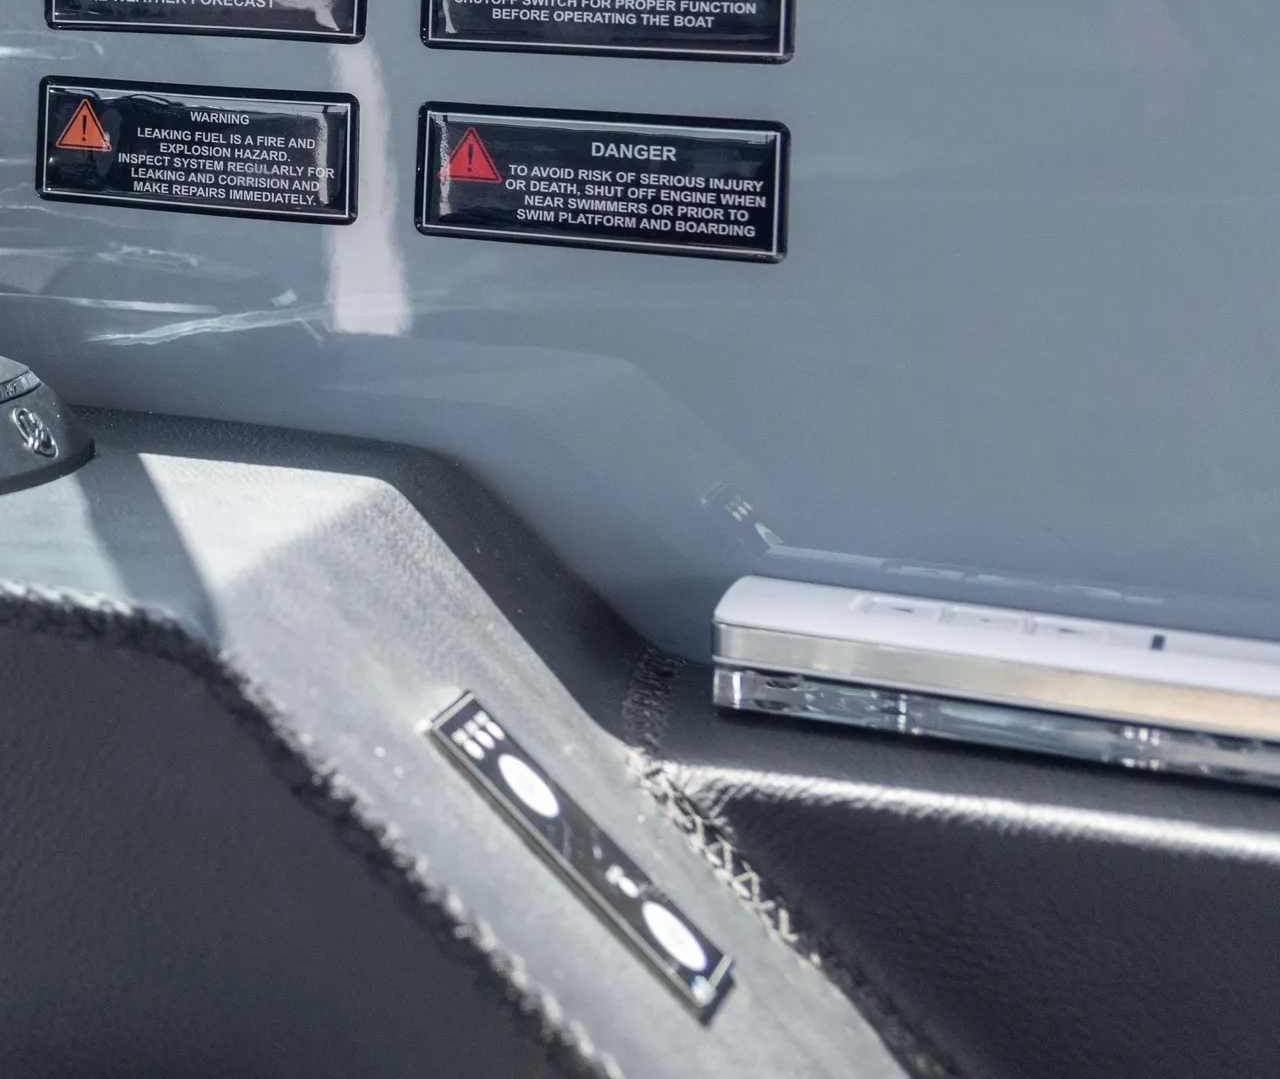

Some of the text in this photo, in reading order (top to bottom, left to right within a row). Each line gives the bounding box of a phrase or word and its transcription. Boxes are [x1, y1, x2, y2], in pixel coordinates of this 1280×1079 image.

[492, 8, 715, 28] BEFORE OPERATING THE BOAT
[680, 1, 756, 14] FUNCTION
[190, 112, 250, 125] WARNING
[138, 128, 316, 149] LEAKING FUEL IS A FIRE AND
[160, 143, 290, 162] EXPLOSION HAZARD.
[591, 142, 677, 161] DANGER
[118, 153, 334, 178] INSPECT SYSTEM REGULARLY FOR
[131, 168, 320, 191] LEAKING AND CORRISION AND
[509, 165, 764, 192] TO AVOID RISK OF SERIOUS INJURY
[134, 181, 316, 206] MAKE REPAIRS IMMEDIATELY.
[505, 179, 766, 207] OR DEATH, SHUT OFF ENGINE WHEN
[524, 195, 749, 221] NEAR SWIMMERS OR PRIOR TO
[516, 209, 756, 237] SWIM PLATFORM AND BOARDING
